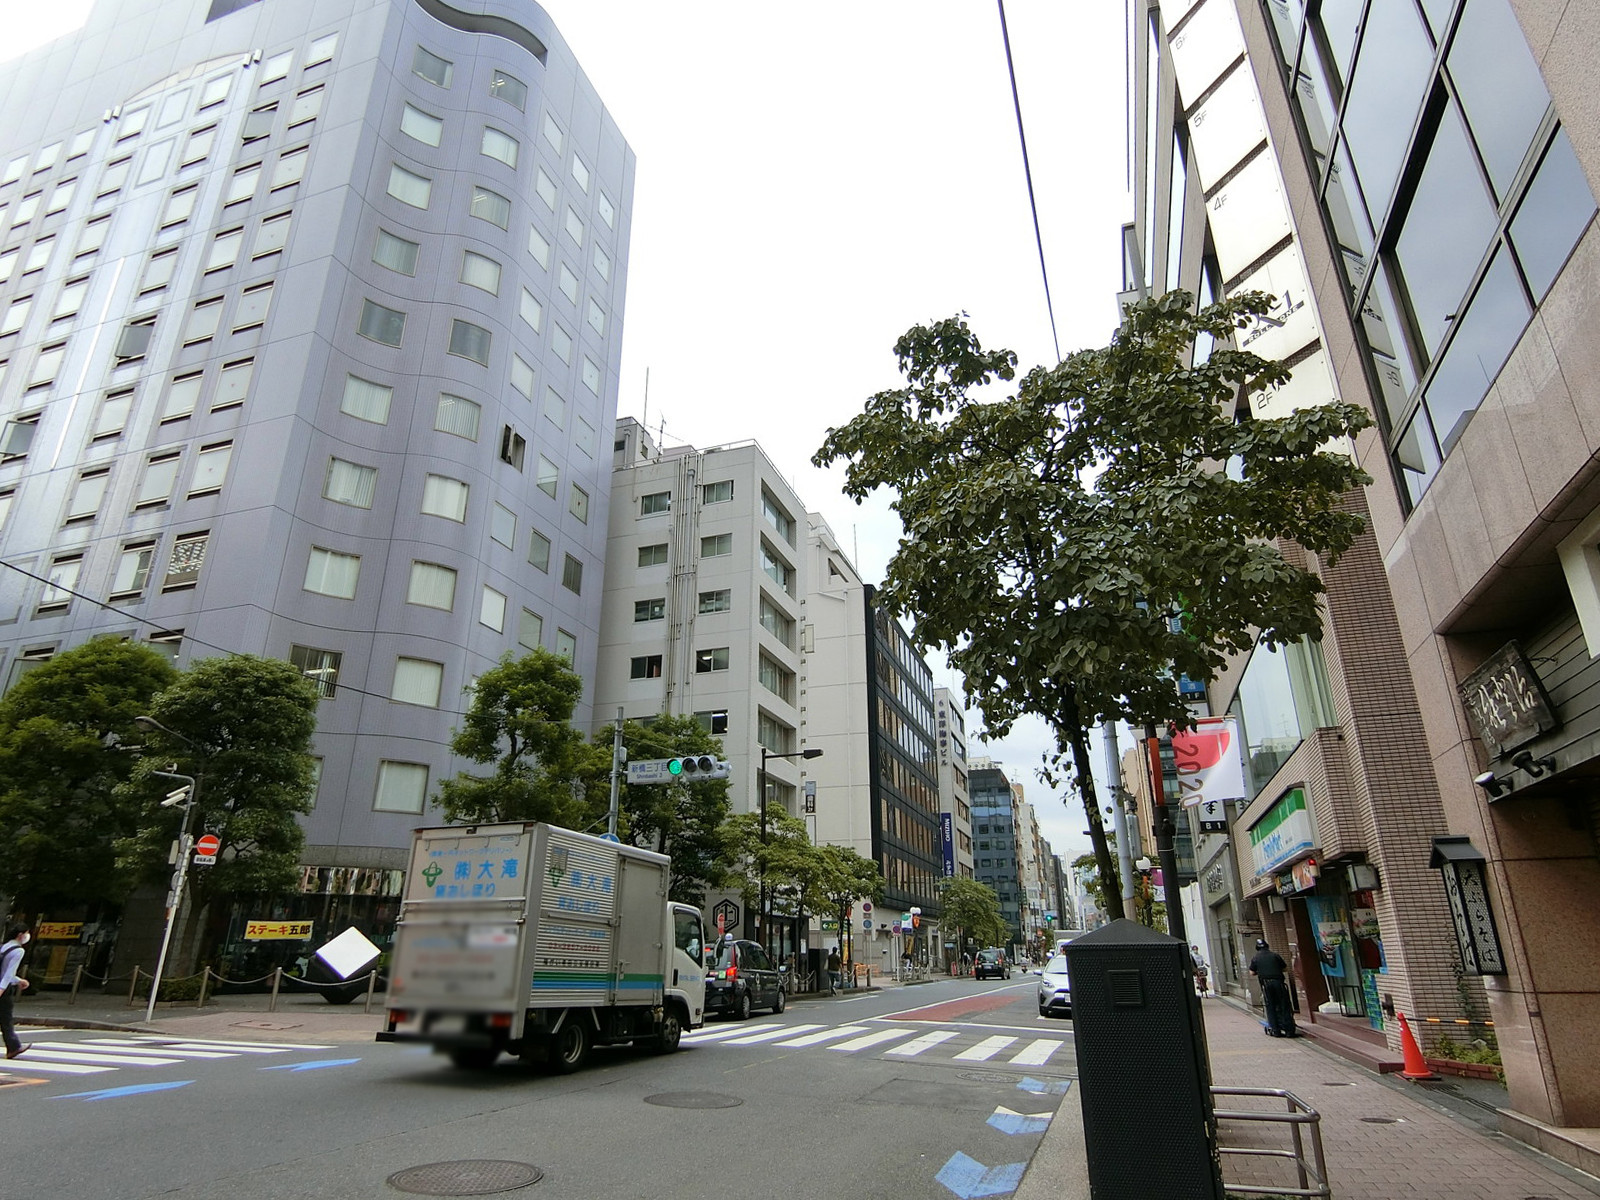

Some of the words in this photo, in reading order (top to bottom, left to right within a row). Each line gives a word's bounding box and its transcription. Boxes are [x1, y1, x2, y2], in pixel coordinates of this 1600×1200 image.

[1193, 110, 1207, 128] 5F
[1214, 194, 1228, 211] 4F
[1257, 391, 1273, 410] 2F
[631, 762, 667, 773] 新橋三丁目
[1174, 744, 1203, 809] 2020
[247, 924, 311, 937] ステーキ五郎
